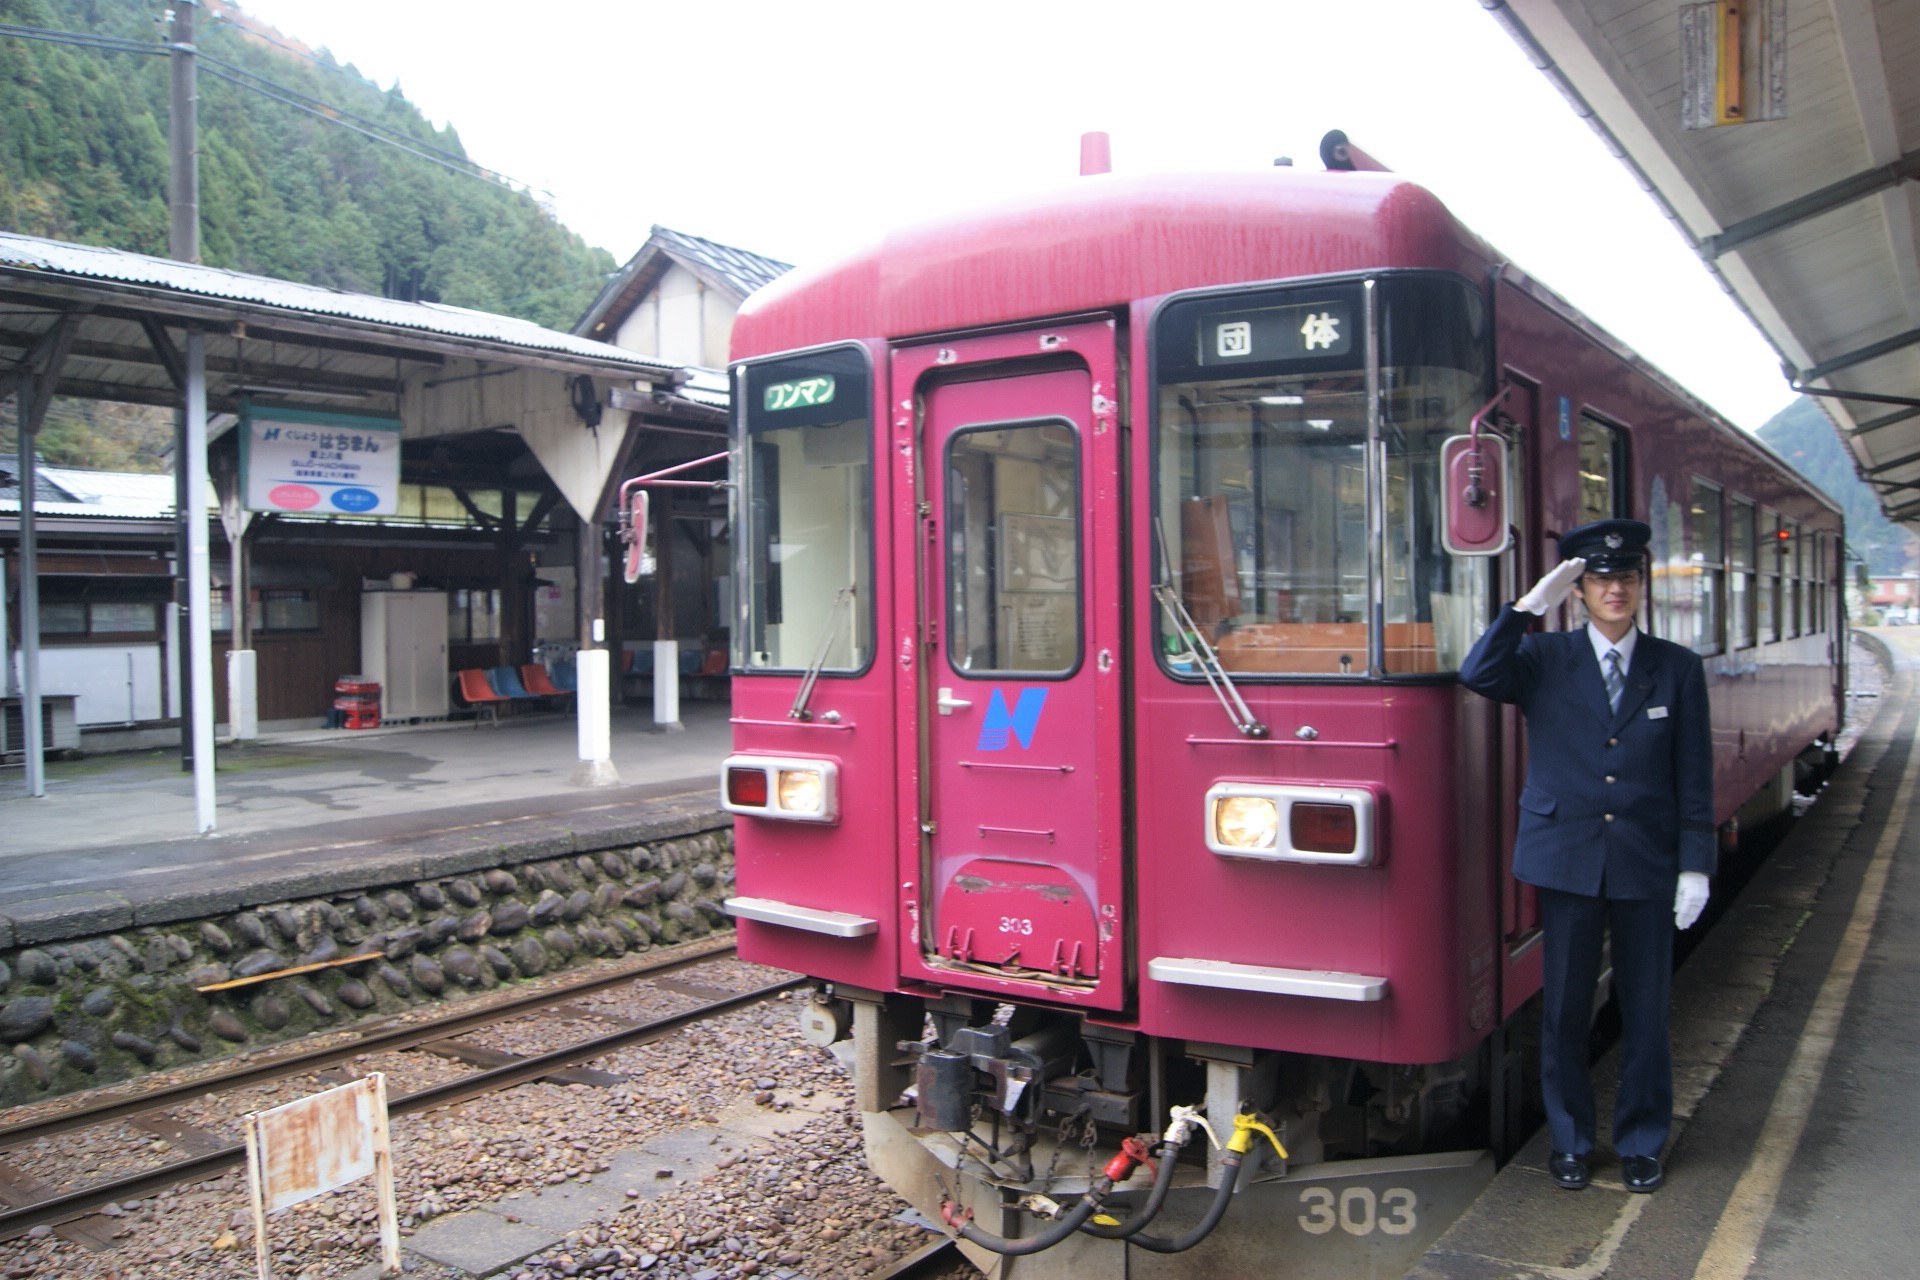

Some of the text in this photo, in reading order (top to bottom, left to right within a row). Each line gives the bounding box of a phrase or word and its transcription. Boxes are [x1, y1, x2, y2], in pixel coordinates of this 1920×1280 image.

[1217, 312, 1341, 357] 団体
[766, 378, 836, 409] ワンマン
[998, 916, 1033, 936] 303
[1297, 1186, 1417, 1236] 303
